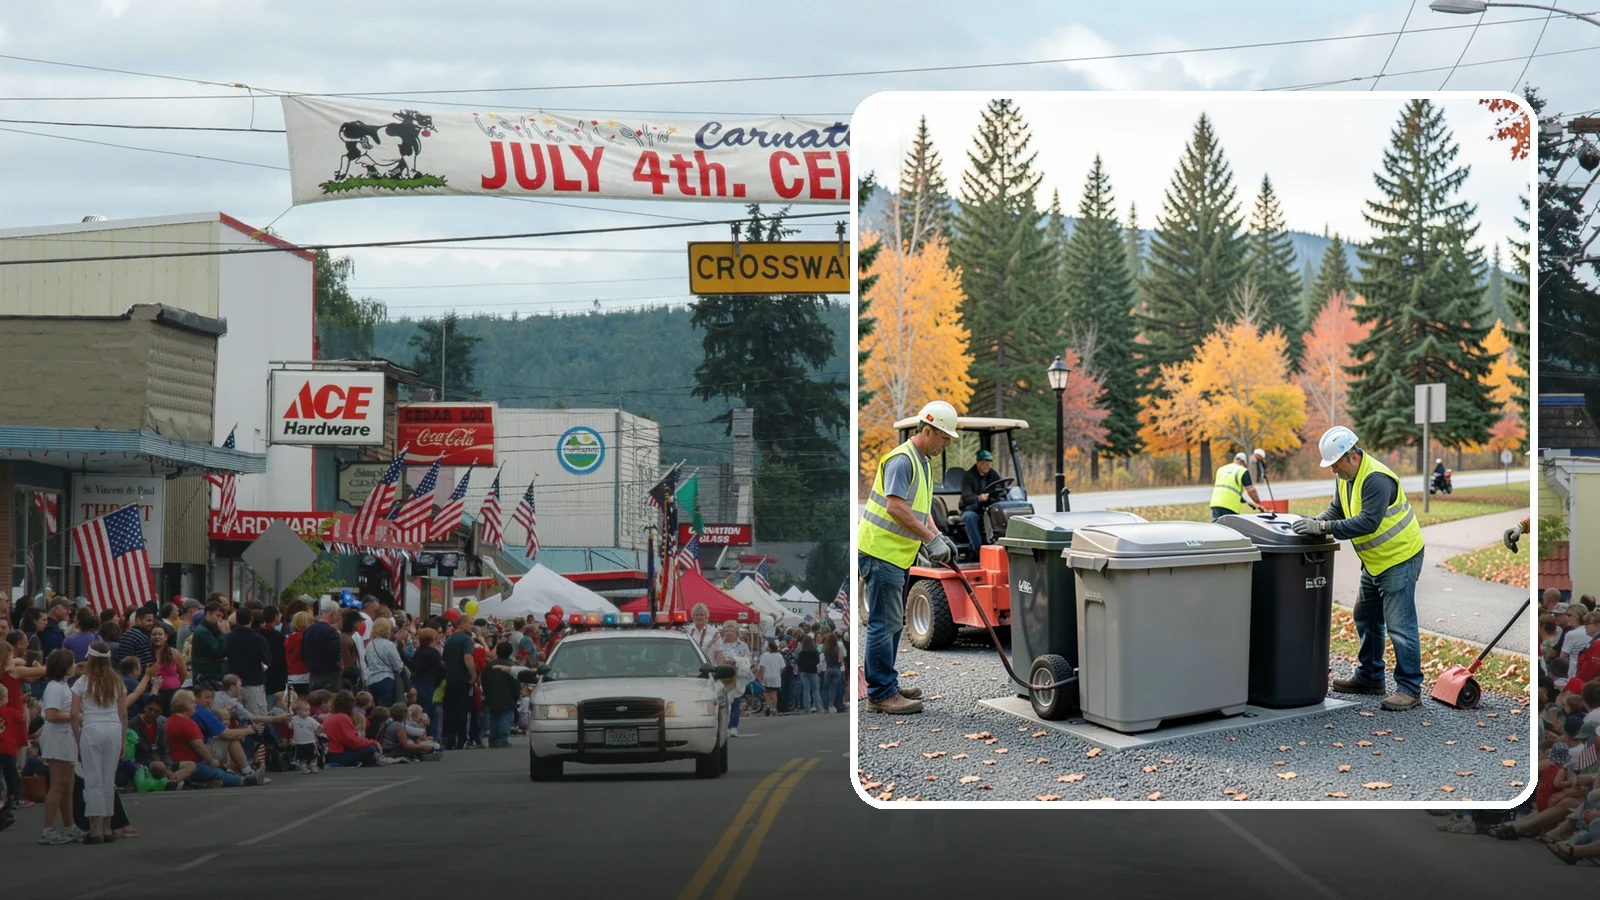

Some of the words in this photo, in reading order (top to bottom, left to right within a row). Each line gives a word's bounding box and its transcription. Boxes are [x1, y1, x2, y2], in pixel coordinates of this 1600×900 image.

[481, 140, 605, 193] JULY
[632, 150, 747, 198] 4th.
[697, 254, 850, 280] CROSSWA
[283, 379, 374, 420] ACE
[406, 409, 452, 422] CEDAR
[283, 421, 371, 436] Hardware
[416, 428, 477, 447] Coca-Cola
[353, 467, 385, 480] Simpl
[83, 484, 93, 494] St.
[96, 485, 124, 495] Vincent
[126, 485, 136, 495] de
[137, 485, 155, 495] Paul
[688, 526, 742, 535] CRNATION
[699, 535, 730, 543] GLASS
